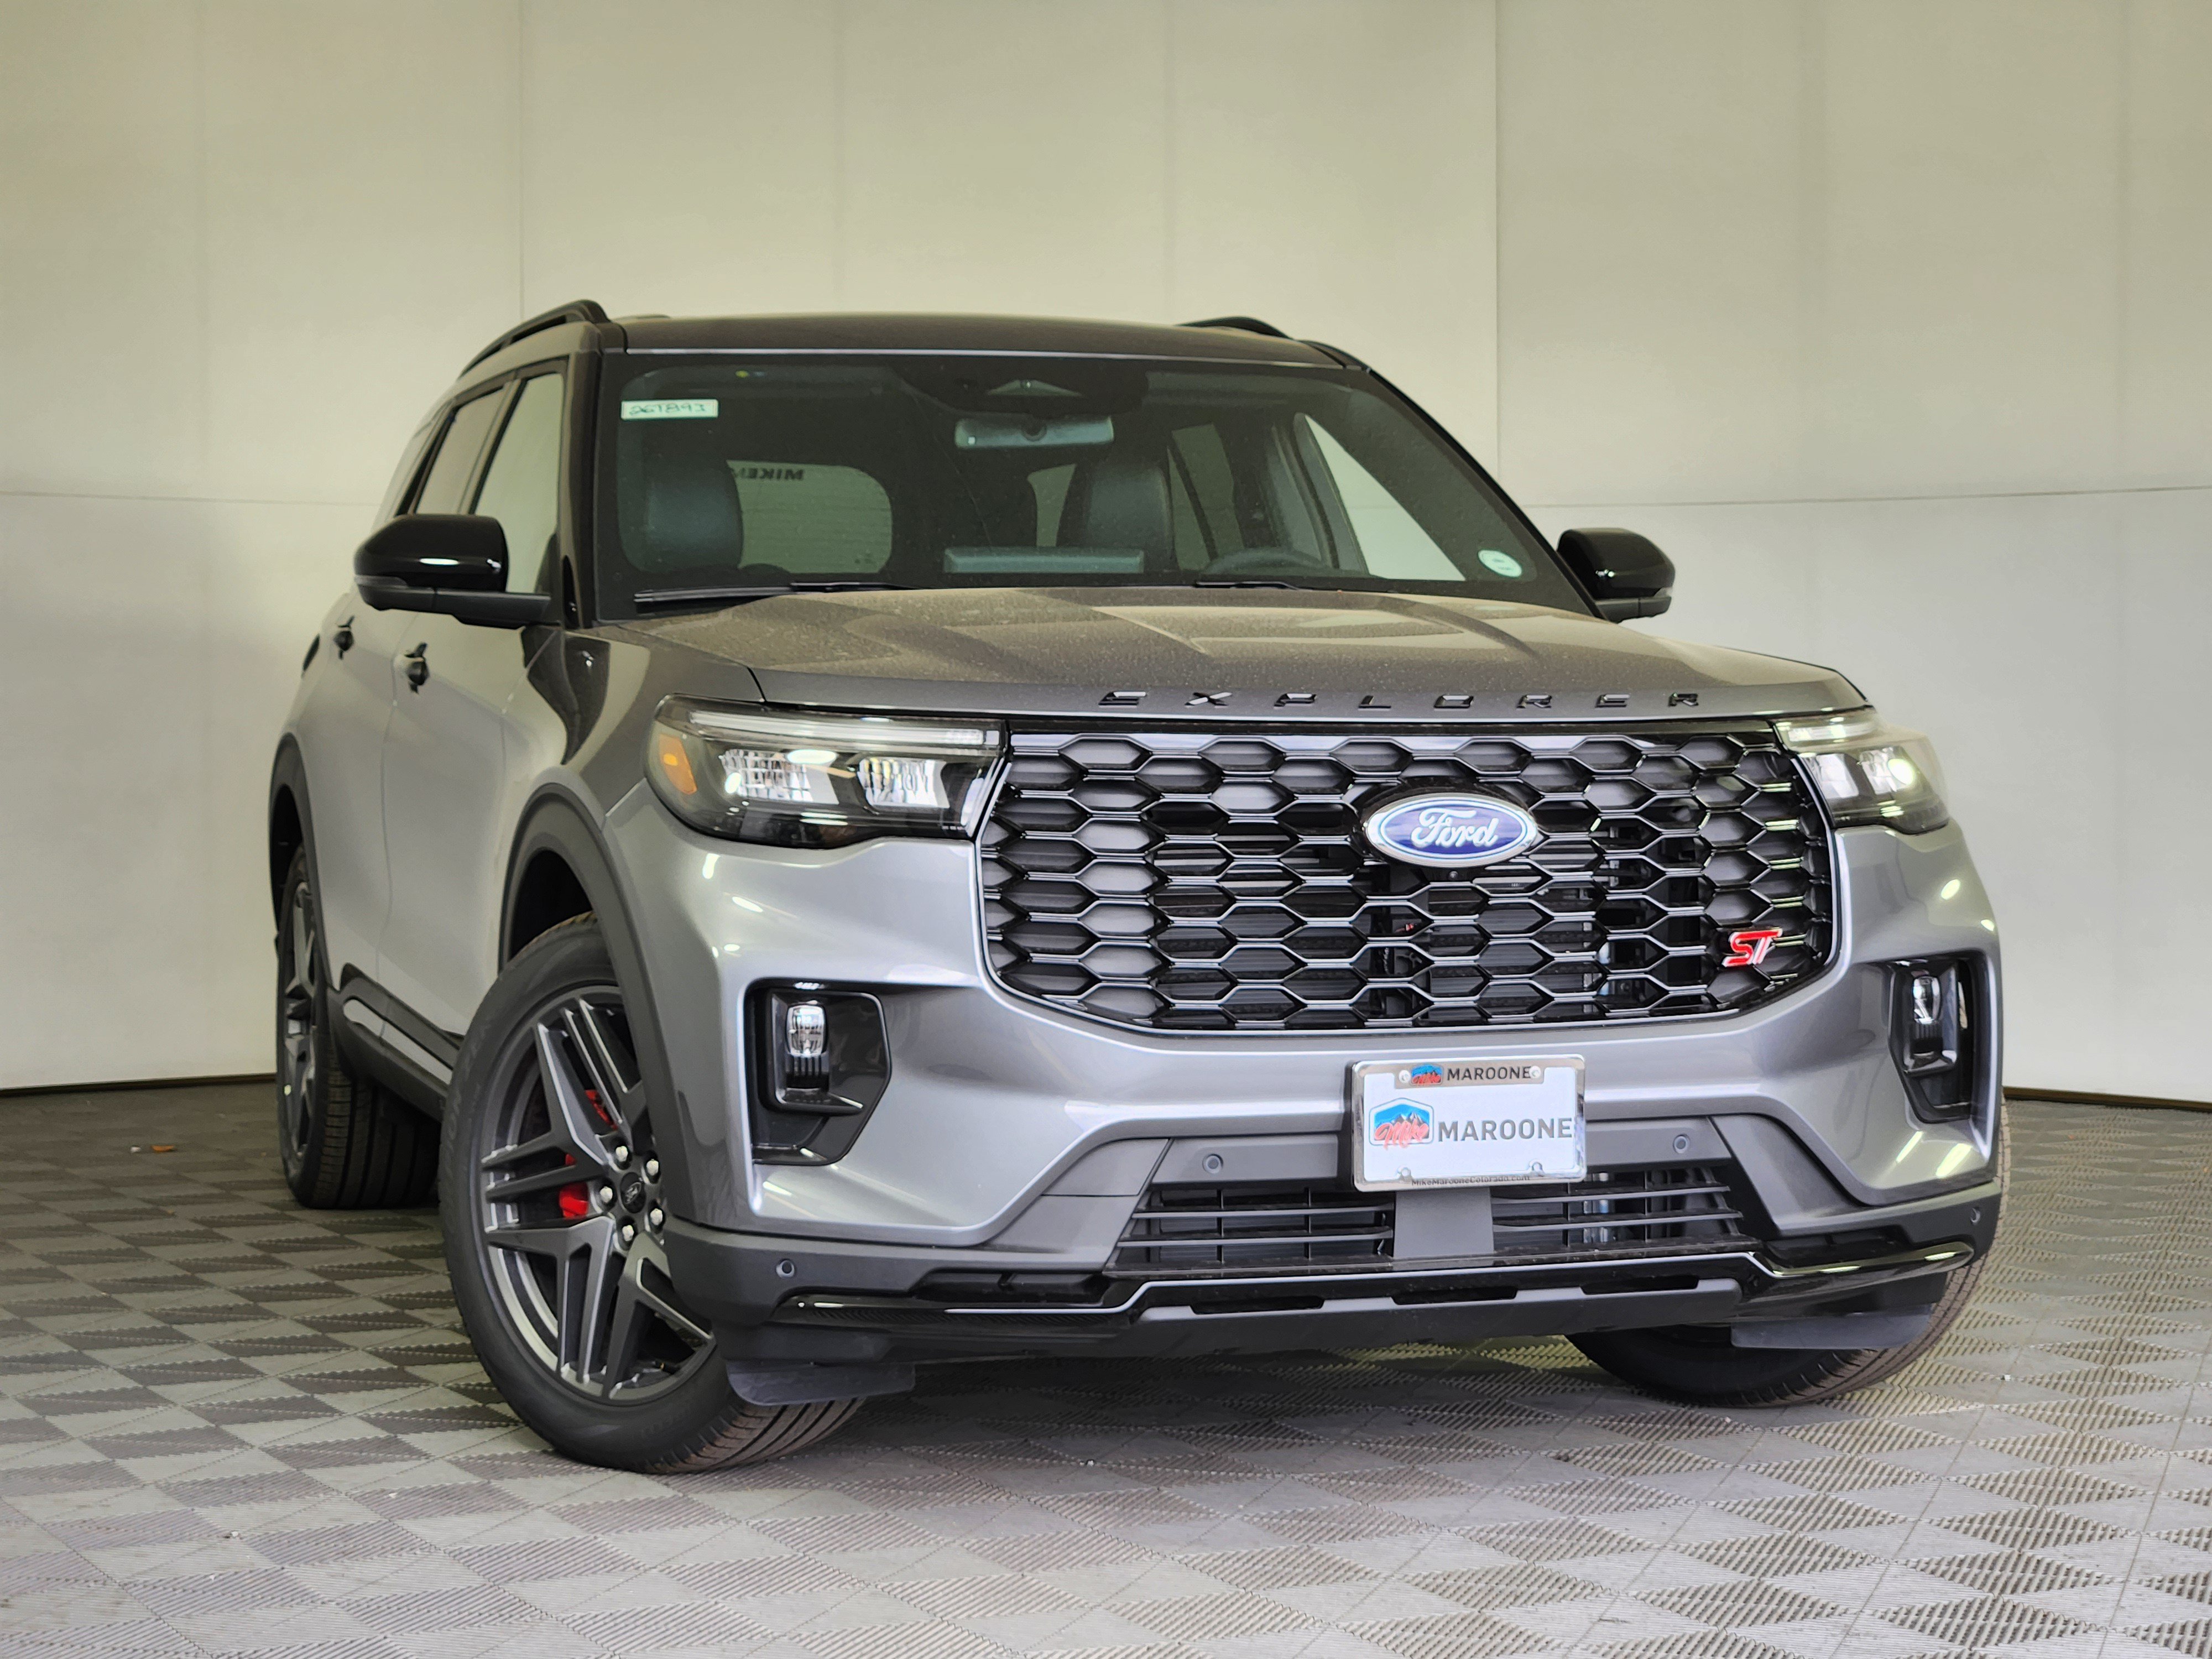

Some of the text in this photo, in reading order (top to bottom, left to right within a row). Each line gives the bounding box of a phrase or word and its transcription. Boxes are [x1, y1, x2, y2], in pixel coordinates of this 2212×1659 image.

[1098, 691, 1700, 709] EXPLORER
[1411, 807, 1499, 848] Ford
[1721, 927, 1783, 967] ST
[1447, 1066, 1532, 1081] MAROONE
[1374, 1117, 1572, 1150] Mike MAROONE
[1411, 1175, 1531, 1187] MikeMarooneColorado.com
